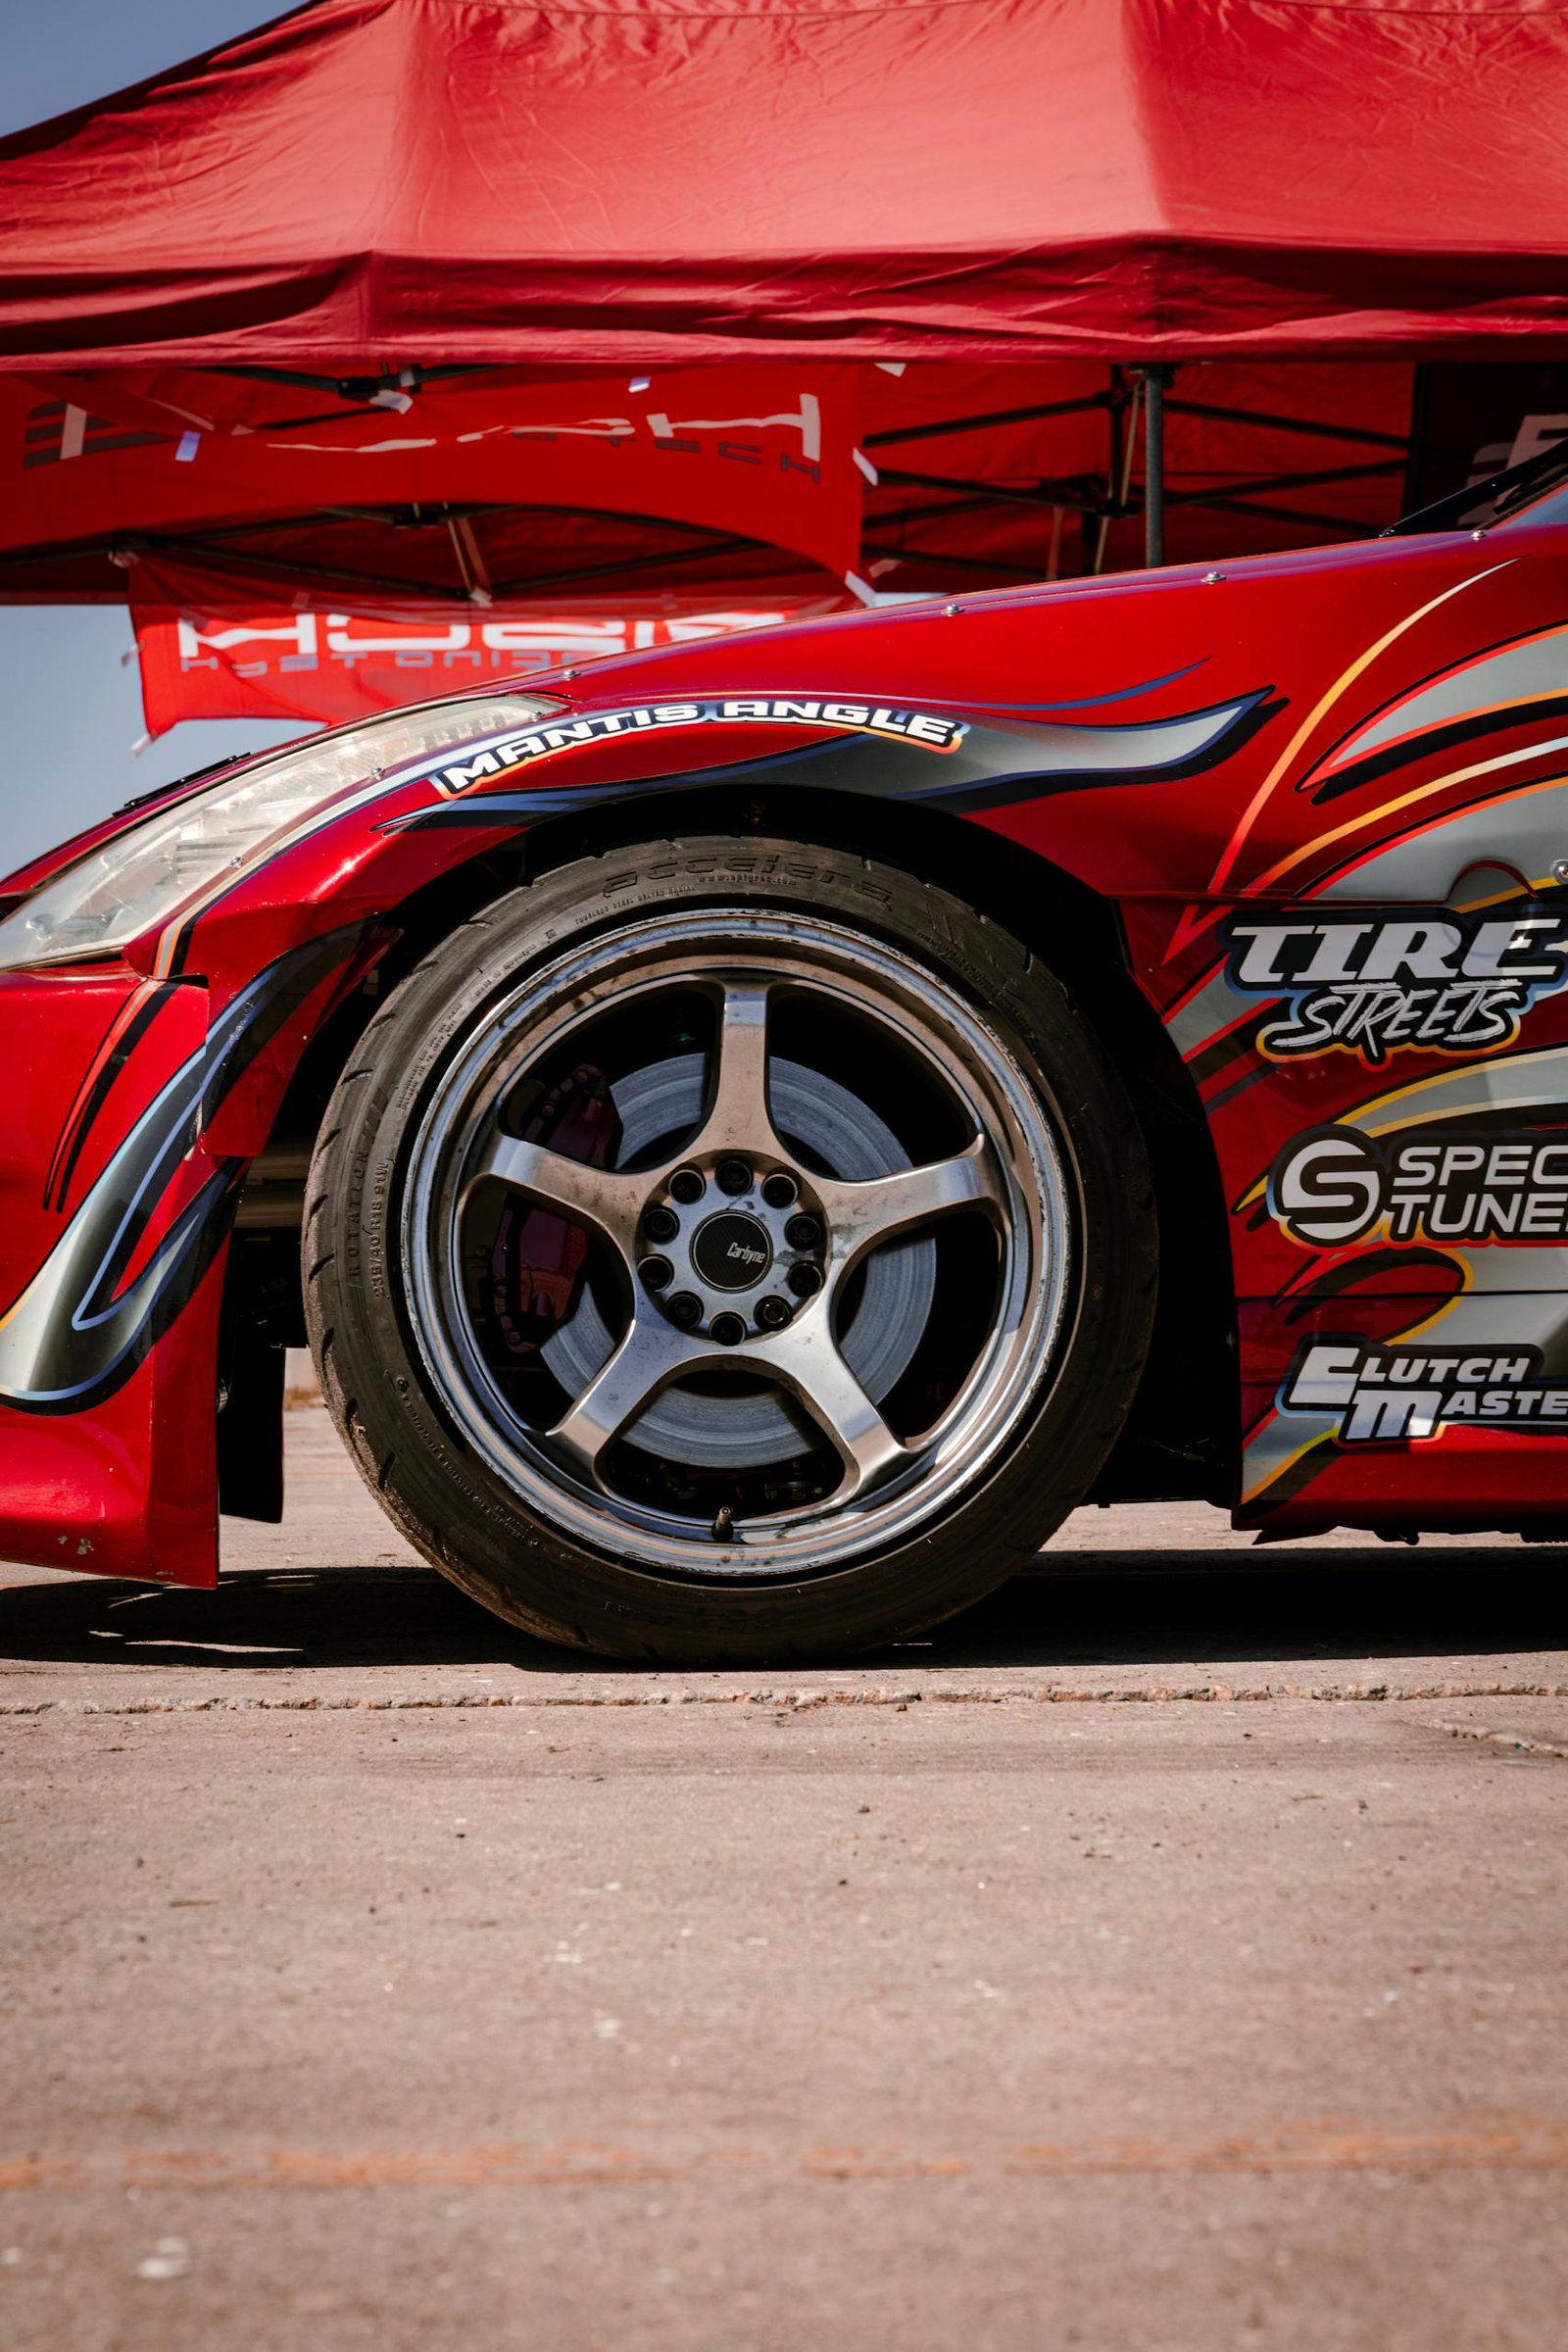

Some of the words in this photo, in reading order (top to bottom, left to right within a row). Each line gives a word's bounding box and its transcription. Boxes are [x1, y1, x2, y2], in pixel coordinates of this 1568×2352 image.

[445, 702, 699, 790] MANTIS
[722, 700, 958, 744] ANGLE
[1231, 917, 1562, 983] TIRE
[1270, 978, 1524, 1057] STREETS
[347, 1151, 368, 1277] ROTATION
[1389, 1193, 1568, 1234] TUNE
[726, 1242, 765, 1264] Carbyne
[1288, 1346, 1531, 1404] CLUTCH
